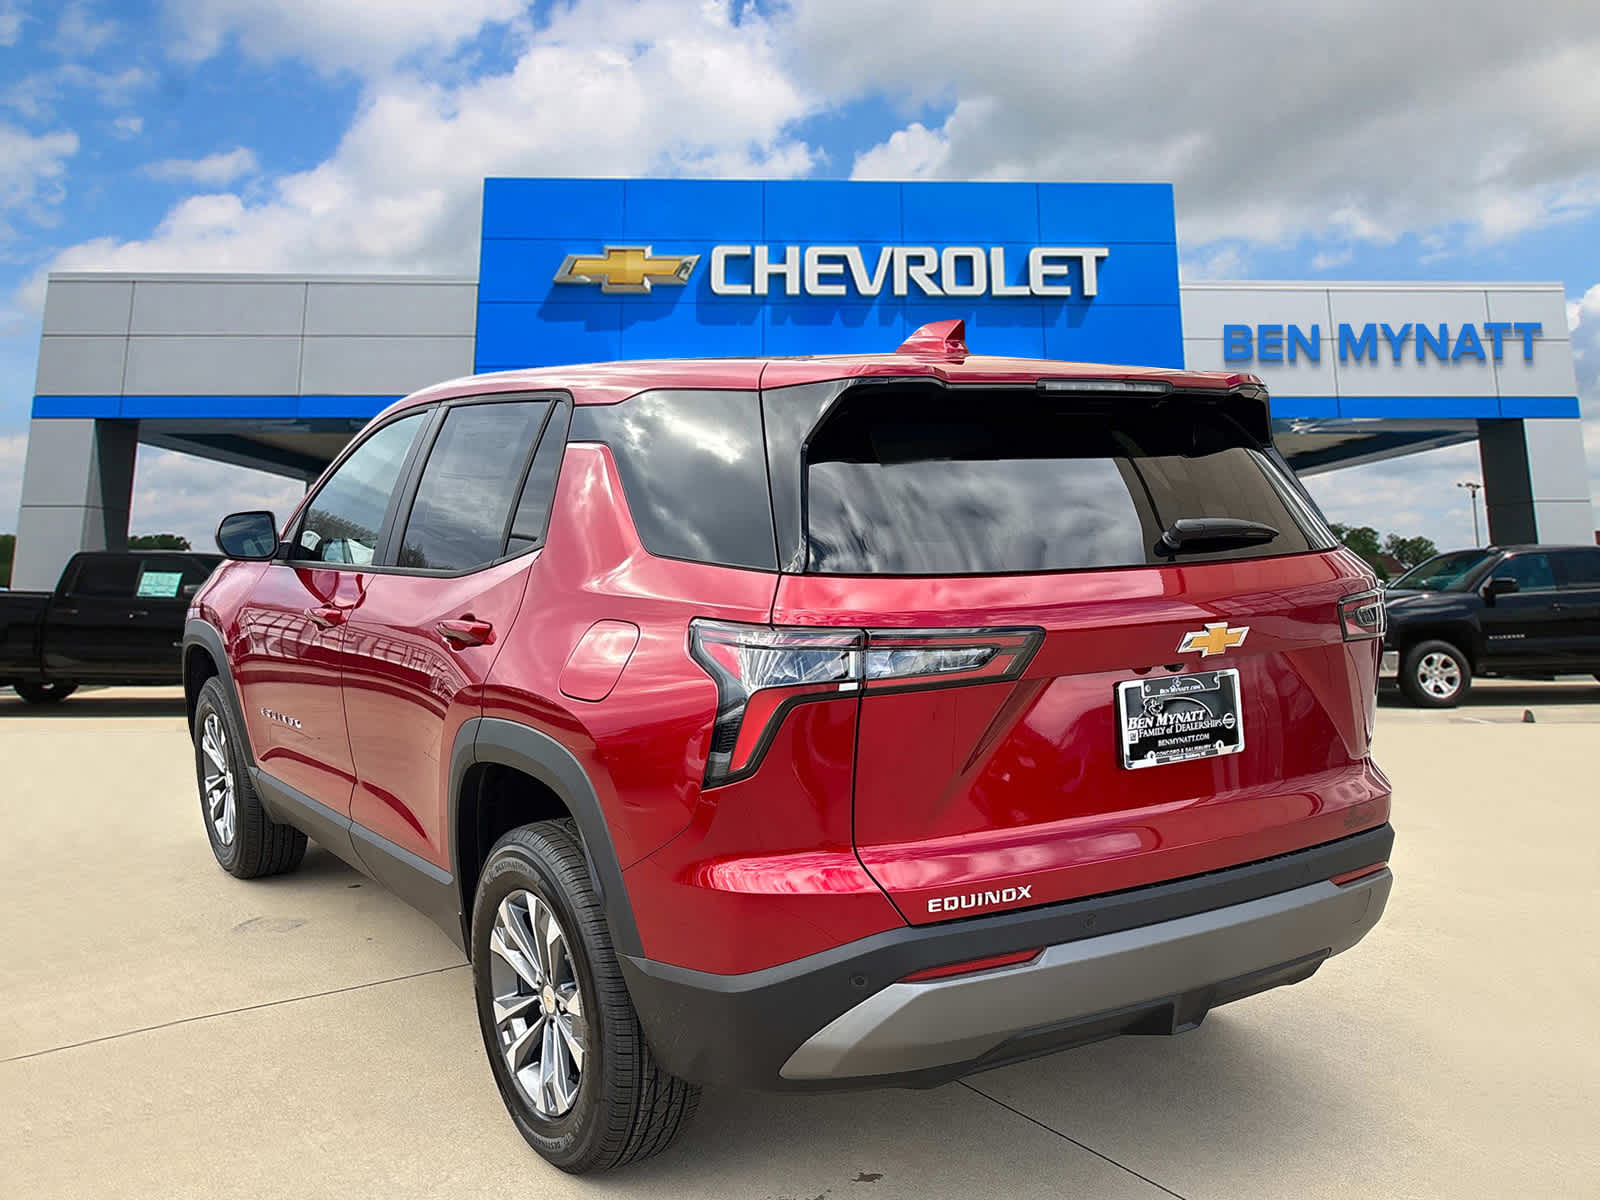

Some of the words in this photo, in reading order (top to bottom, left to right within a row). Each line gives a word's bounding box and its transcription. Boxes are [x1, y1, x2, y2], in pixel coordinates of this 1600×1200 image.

[710, 245, 1109, 297] CHEVROLET
[1223, 324, 1320, 361] BEN
[1338, 322, 1543, 361] MYNATT
[1128, 716, 1155, 730] BEN
[1156, 710, 1206, 726] MYNATT
[1138, 726, 1166, 738] FAMILY
[1165, 725, 1174, 734] of
[1175, 719, 1223, 733] DEALERSHIPS
[927, 885, 1032, 913] EQUINOX
